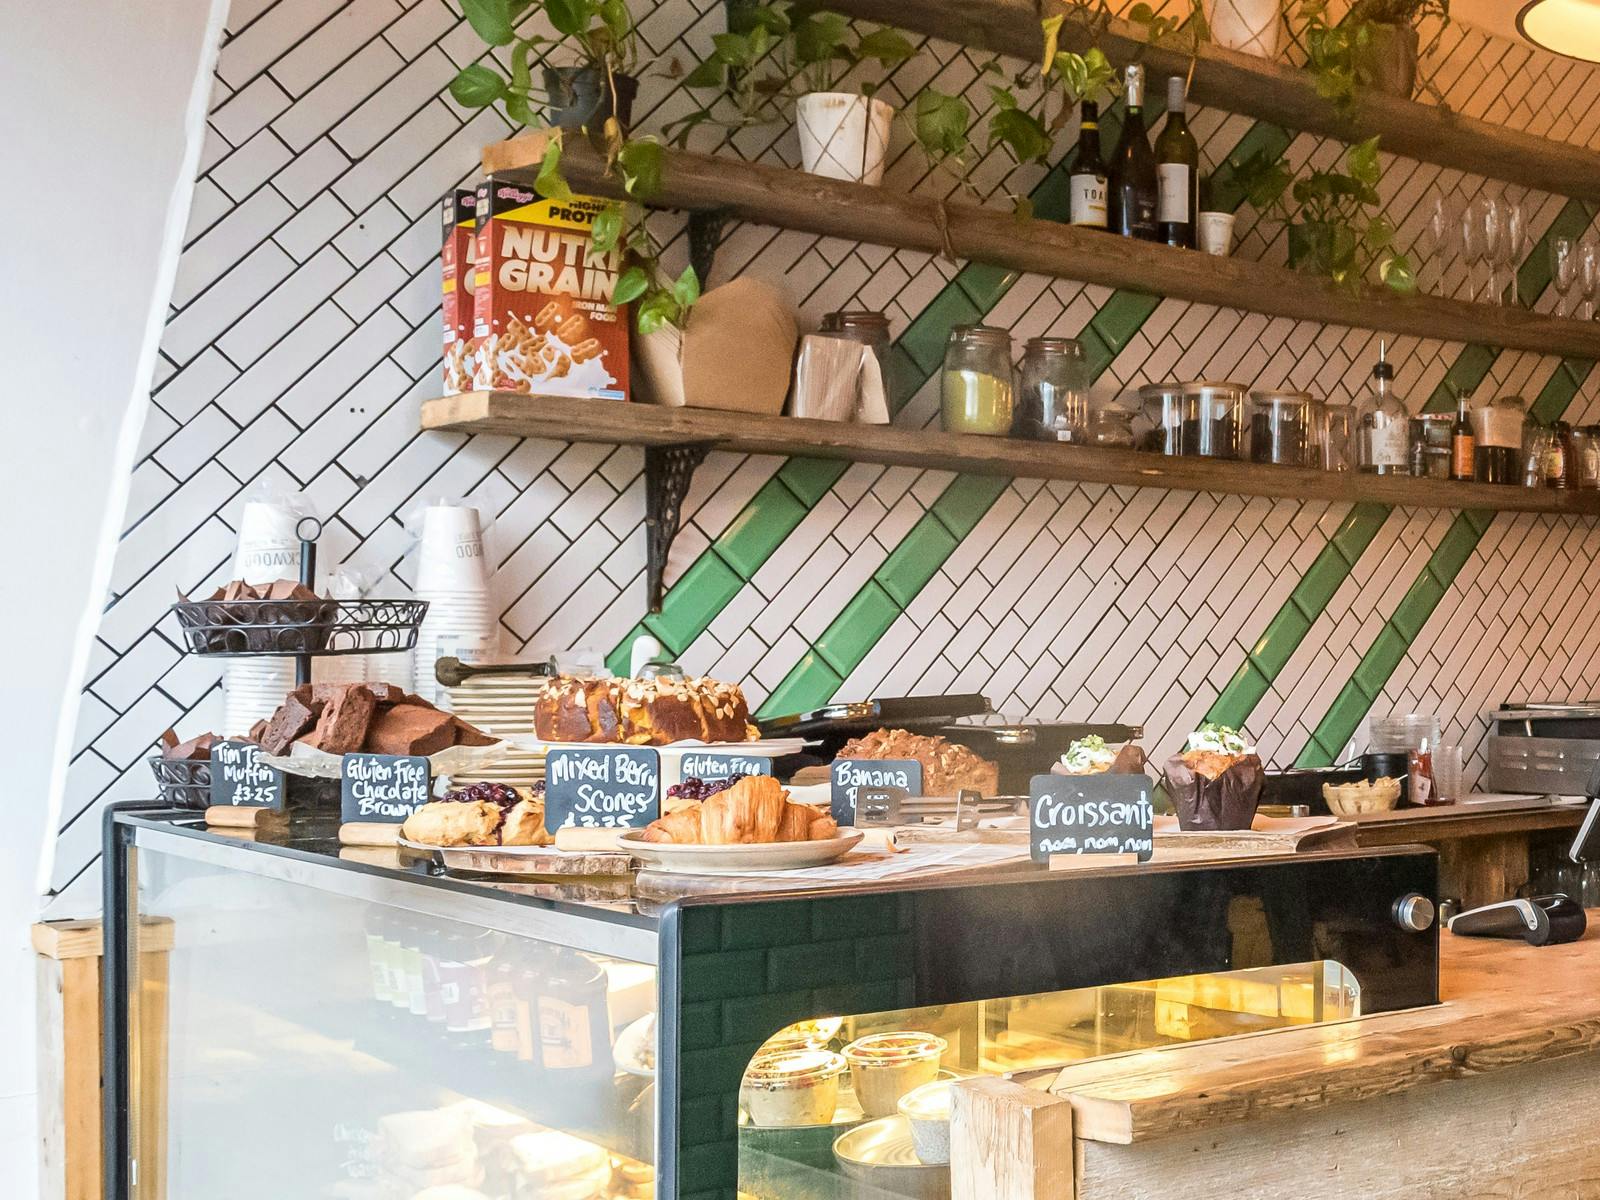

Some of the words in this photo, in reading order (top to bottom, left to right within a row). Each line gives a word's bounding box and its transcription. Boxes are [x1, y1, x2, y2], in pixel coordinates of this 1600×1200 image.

[549, 206, 596, 225] PROT
[499, 259, 619, 301] GRAIN
[212, 742, 240, 764] Tim
[241, 745, 265, 768] Ta
[683, 757, 727, 776] Gluten
[729, 758, 761, 776] Free
[224, 763, 274, 786] Muffin
[347, 757, 392, 783] Gluten
[393, 759, 425, 784] Free
[552, 753, 610, 785] Mixed
[614, 754, 657, 802] Berry
[835, 761, 908, 787] Banana
[232, 783, 277, 806] £3.25
[352, 780, 428, 804] Chocolate
[575, 784, 648, 813] Scones
[358, 798, 425, 816] Brown
[1035, 790, 1154, 830] Croissants
